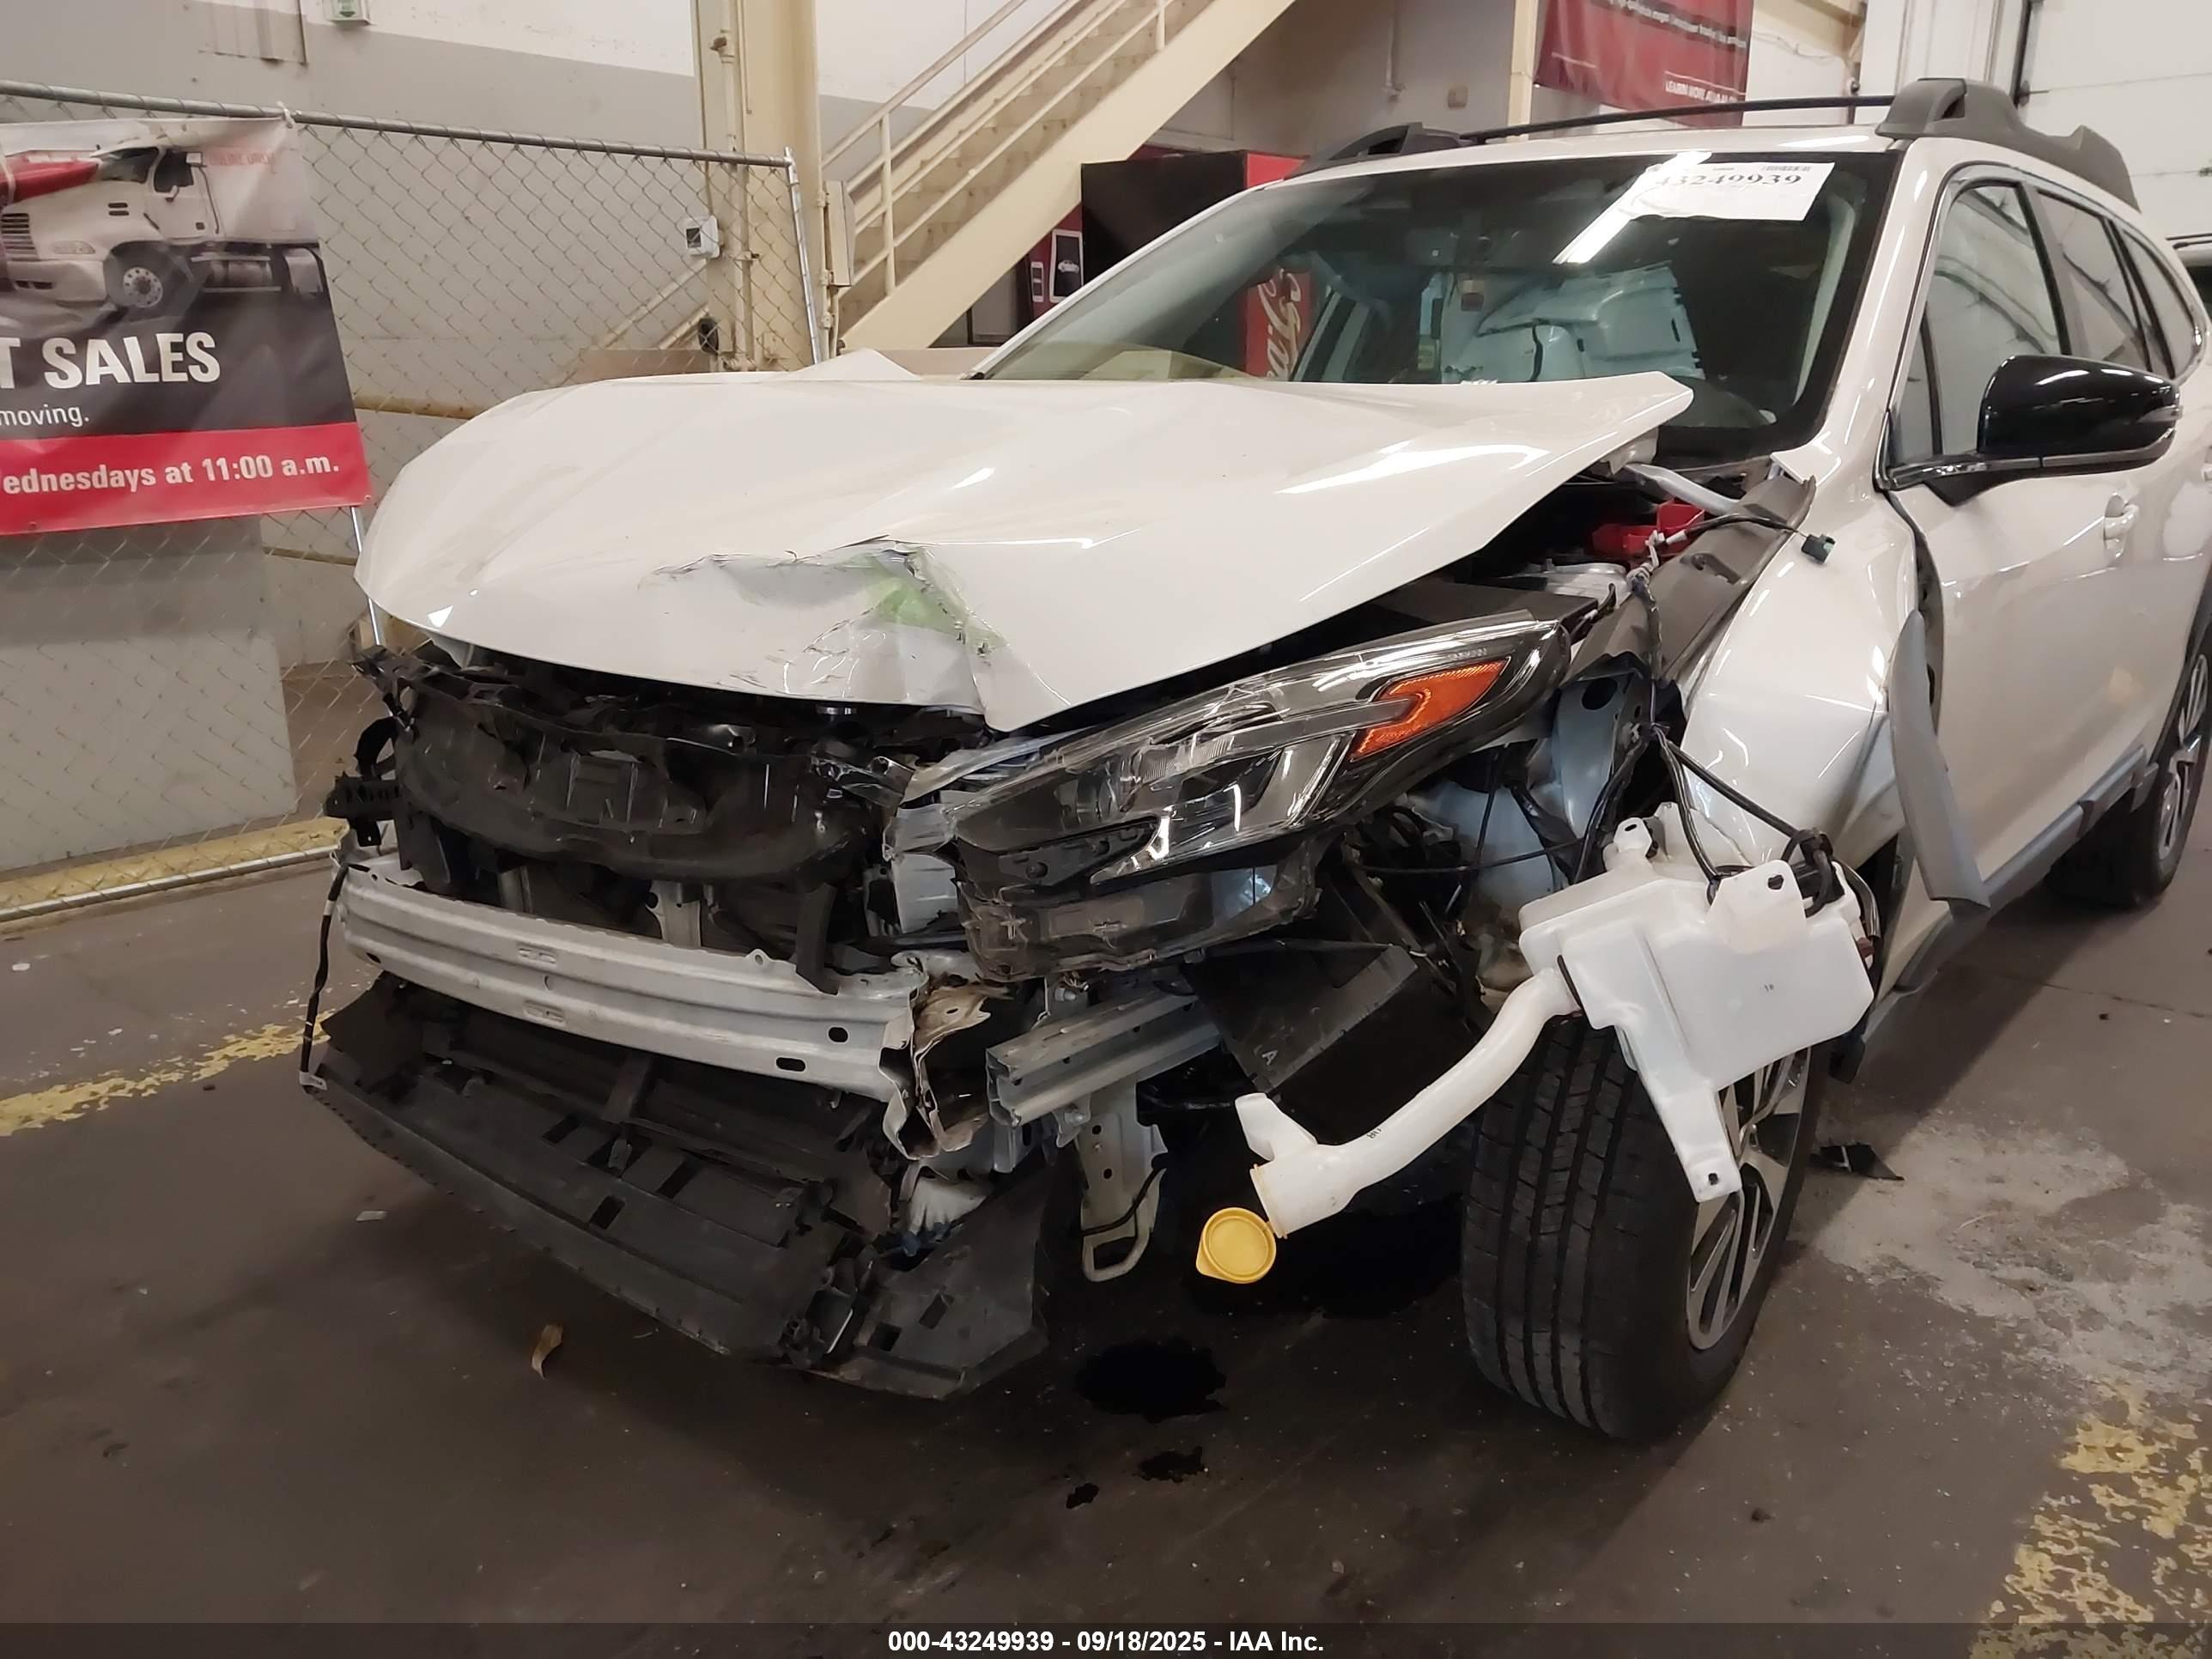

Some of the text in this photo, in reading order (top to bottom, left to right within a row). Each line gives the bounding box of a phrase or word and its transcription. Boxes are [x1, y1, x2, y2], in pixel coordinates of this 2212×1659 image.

[42, 331, 220, 389] SALES
[0, 455, 339, 495] ednesdays at 11:00 a.m.
